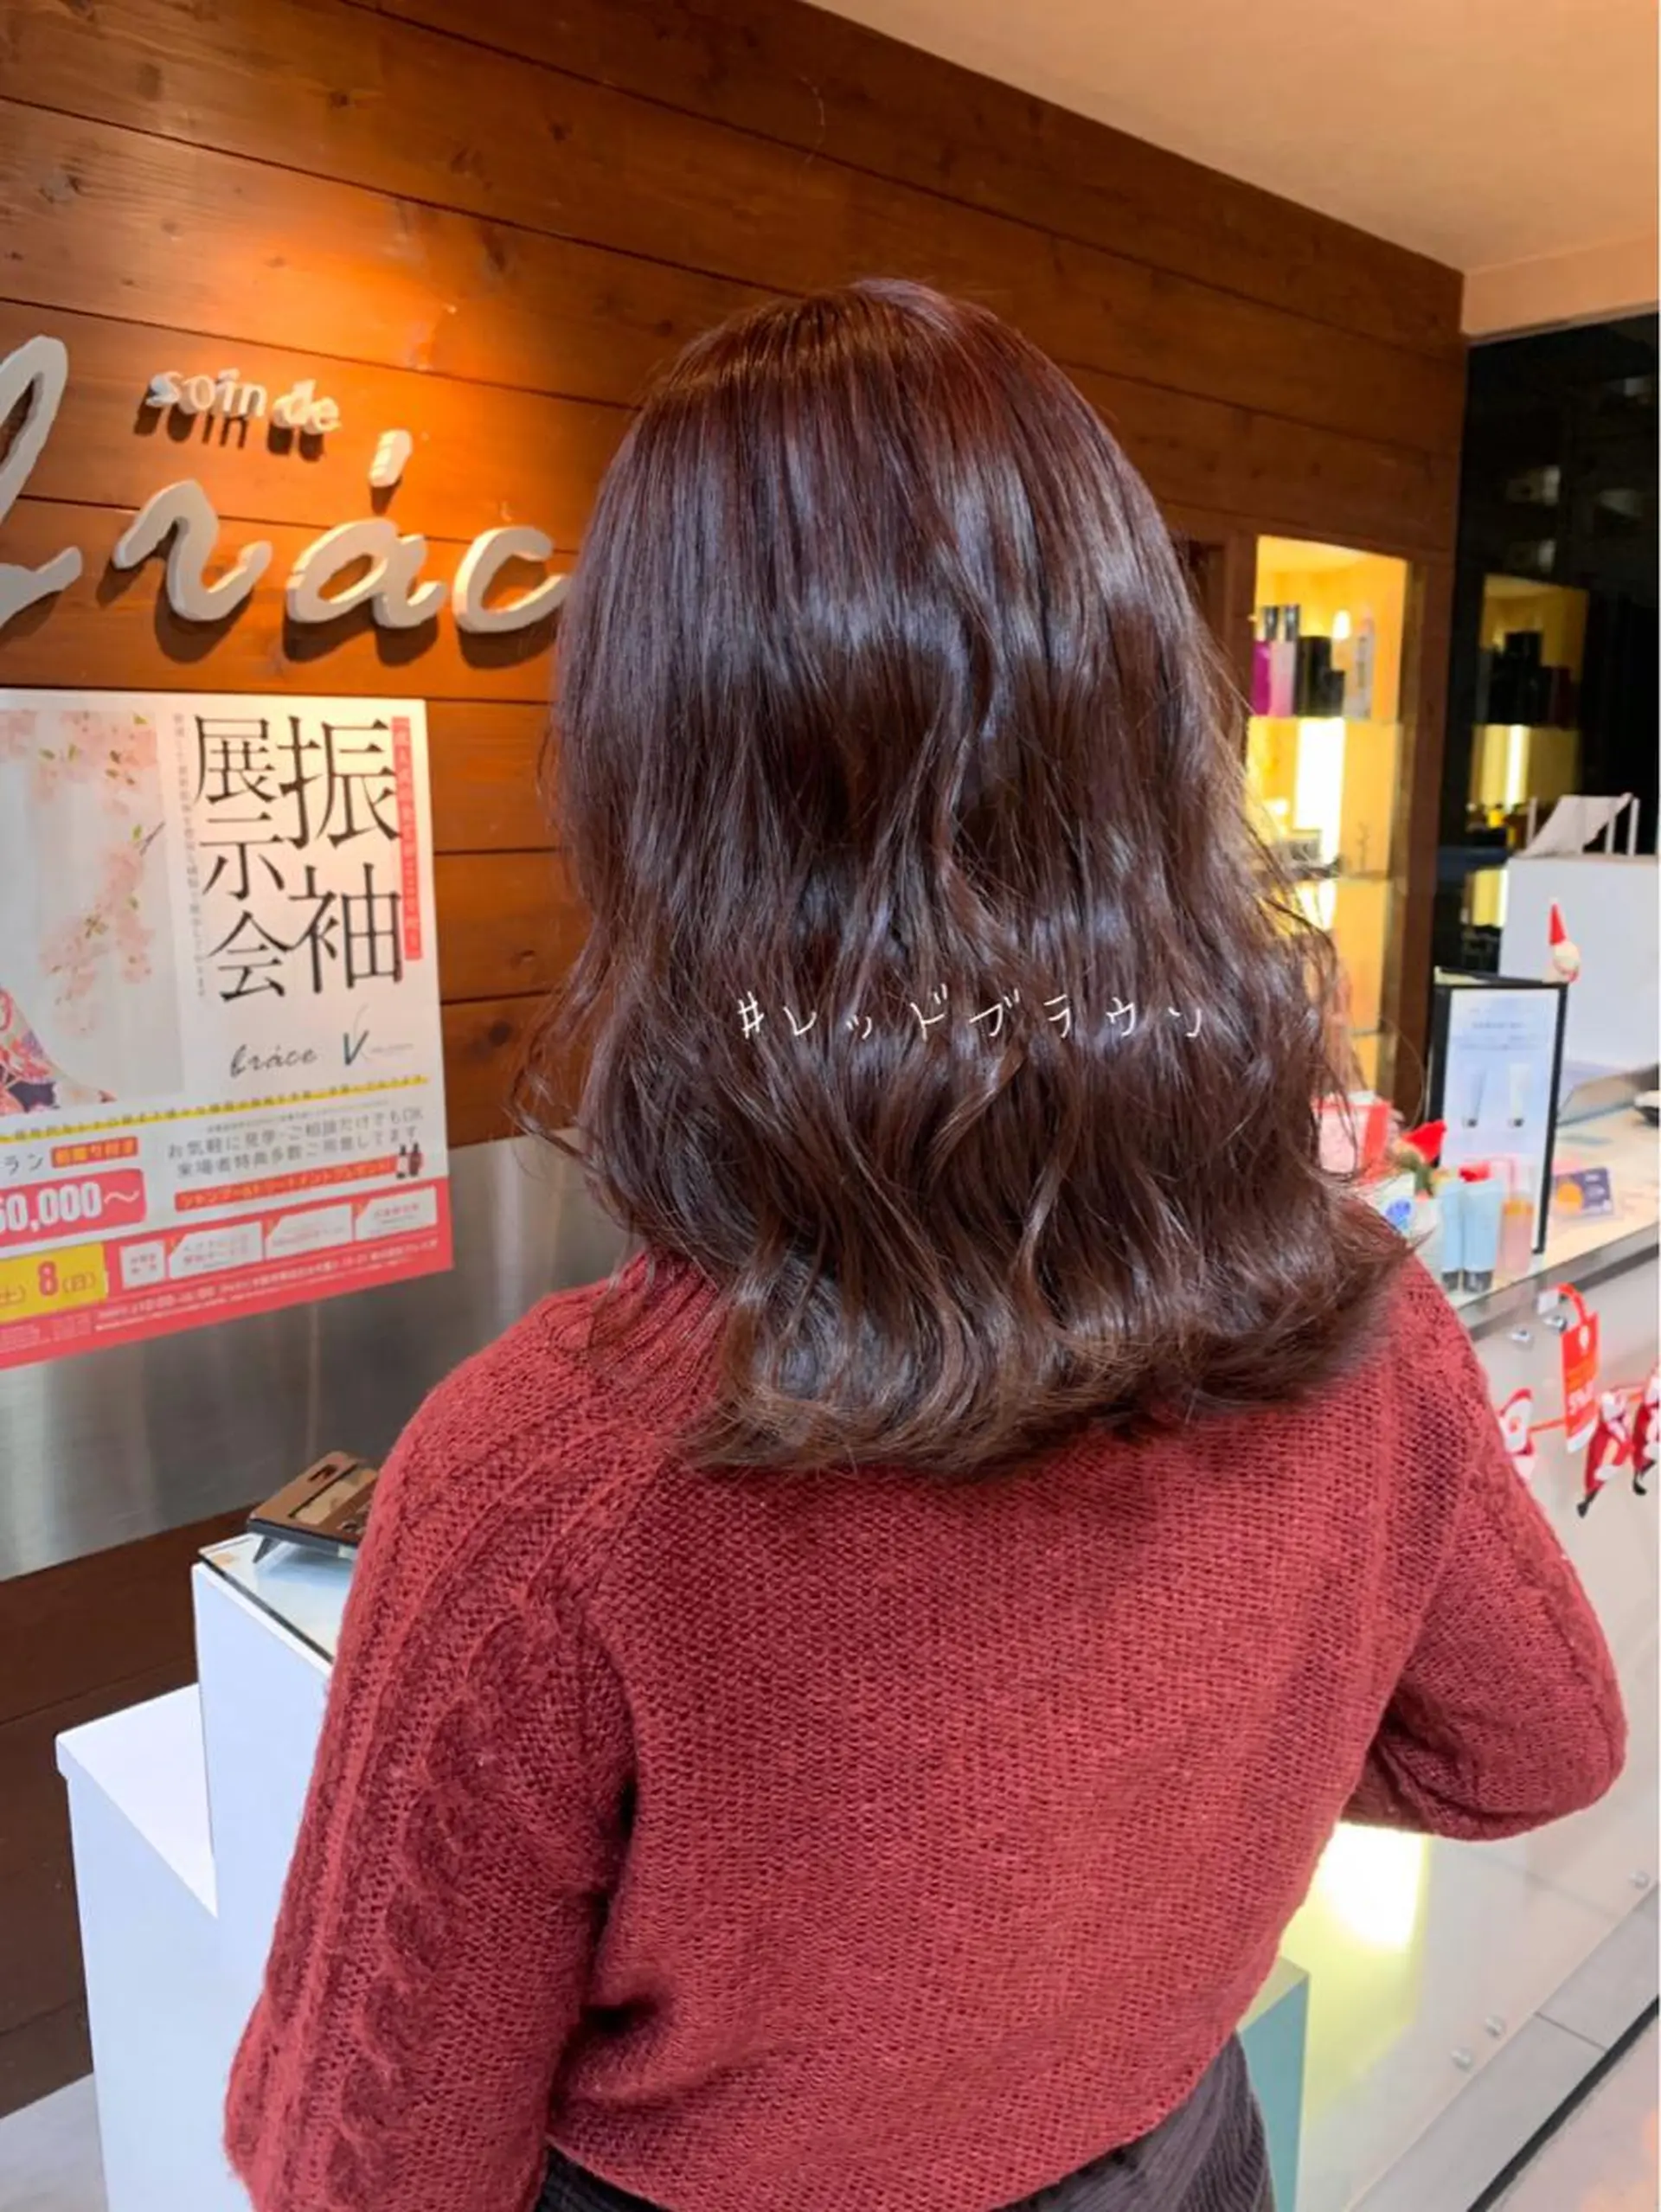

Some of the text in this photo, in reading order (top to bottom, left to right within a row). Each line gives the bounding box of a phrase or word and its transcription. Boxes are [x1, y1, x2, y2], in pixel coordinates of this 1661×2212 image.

[273, 378, 342, 435] de
[194, 715, 287, 1003] 展示会
[276, 715, 401, 995] 振袖
